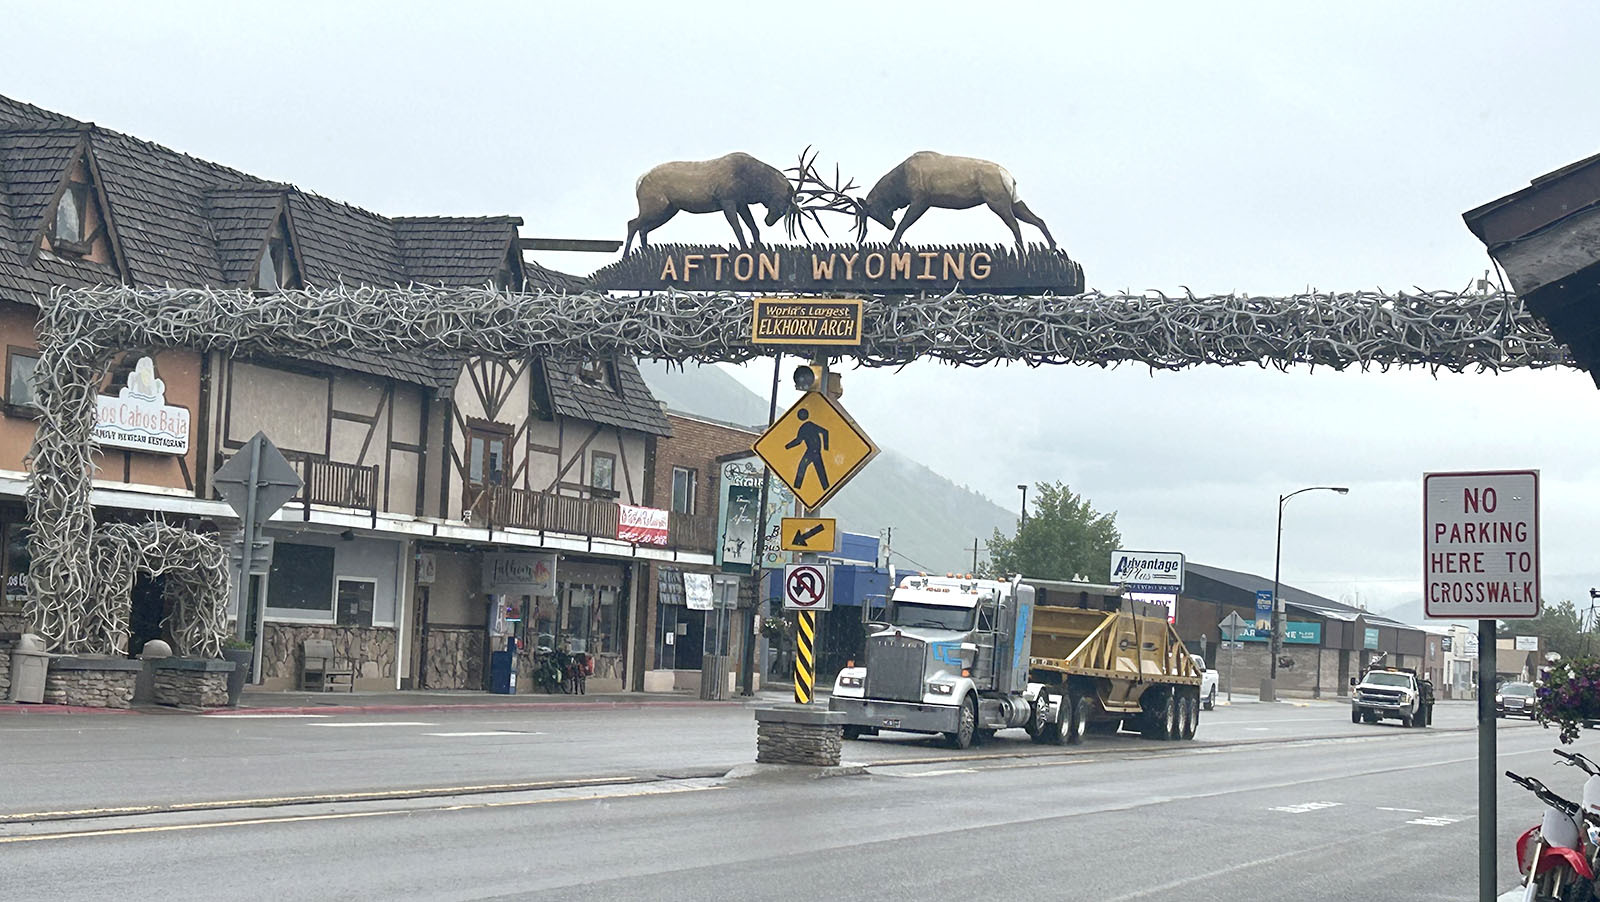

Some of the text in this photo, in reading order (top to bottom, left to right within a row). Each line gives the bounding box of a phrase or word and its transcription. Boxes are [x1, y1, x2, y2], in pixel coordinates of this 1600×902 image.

[660, 252, 992, 282] AFTON WYOMING
[766, 305, 850, 317] World's Largest
[758, 319, 854, 336] ELKHORN ARCH
[119, 403, 158, 431] Cabos
[159, 409, 187, 436] Baja
[148, 436, 186, 449] RESTAURANT
[1464, 487, 1497, 514] NO
[1435, 521, 1527, 544] PARKING
[1114, 556, 1179, 575] Advantage
[1431, 551, 1531, 573] HERE TO
[1121, 567, 1151, 581] Plus
[1430, 581, 1533, 603] CROSSWALK
